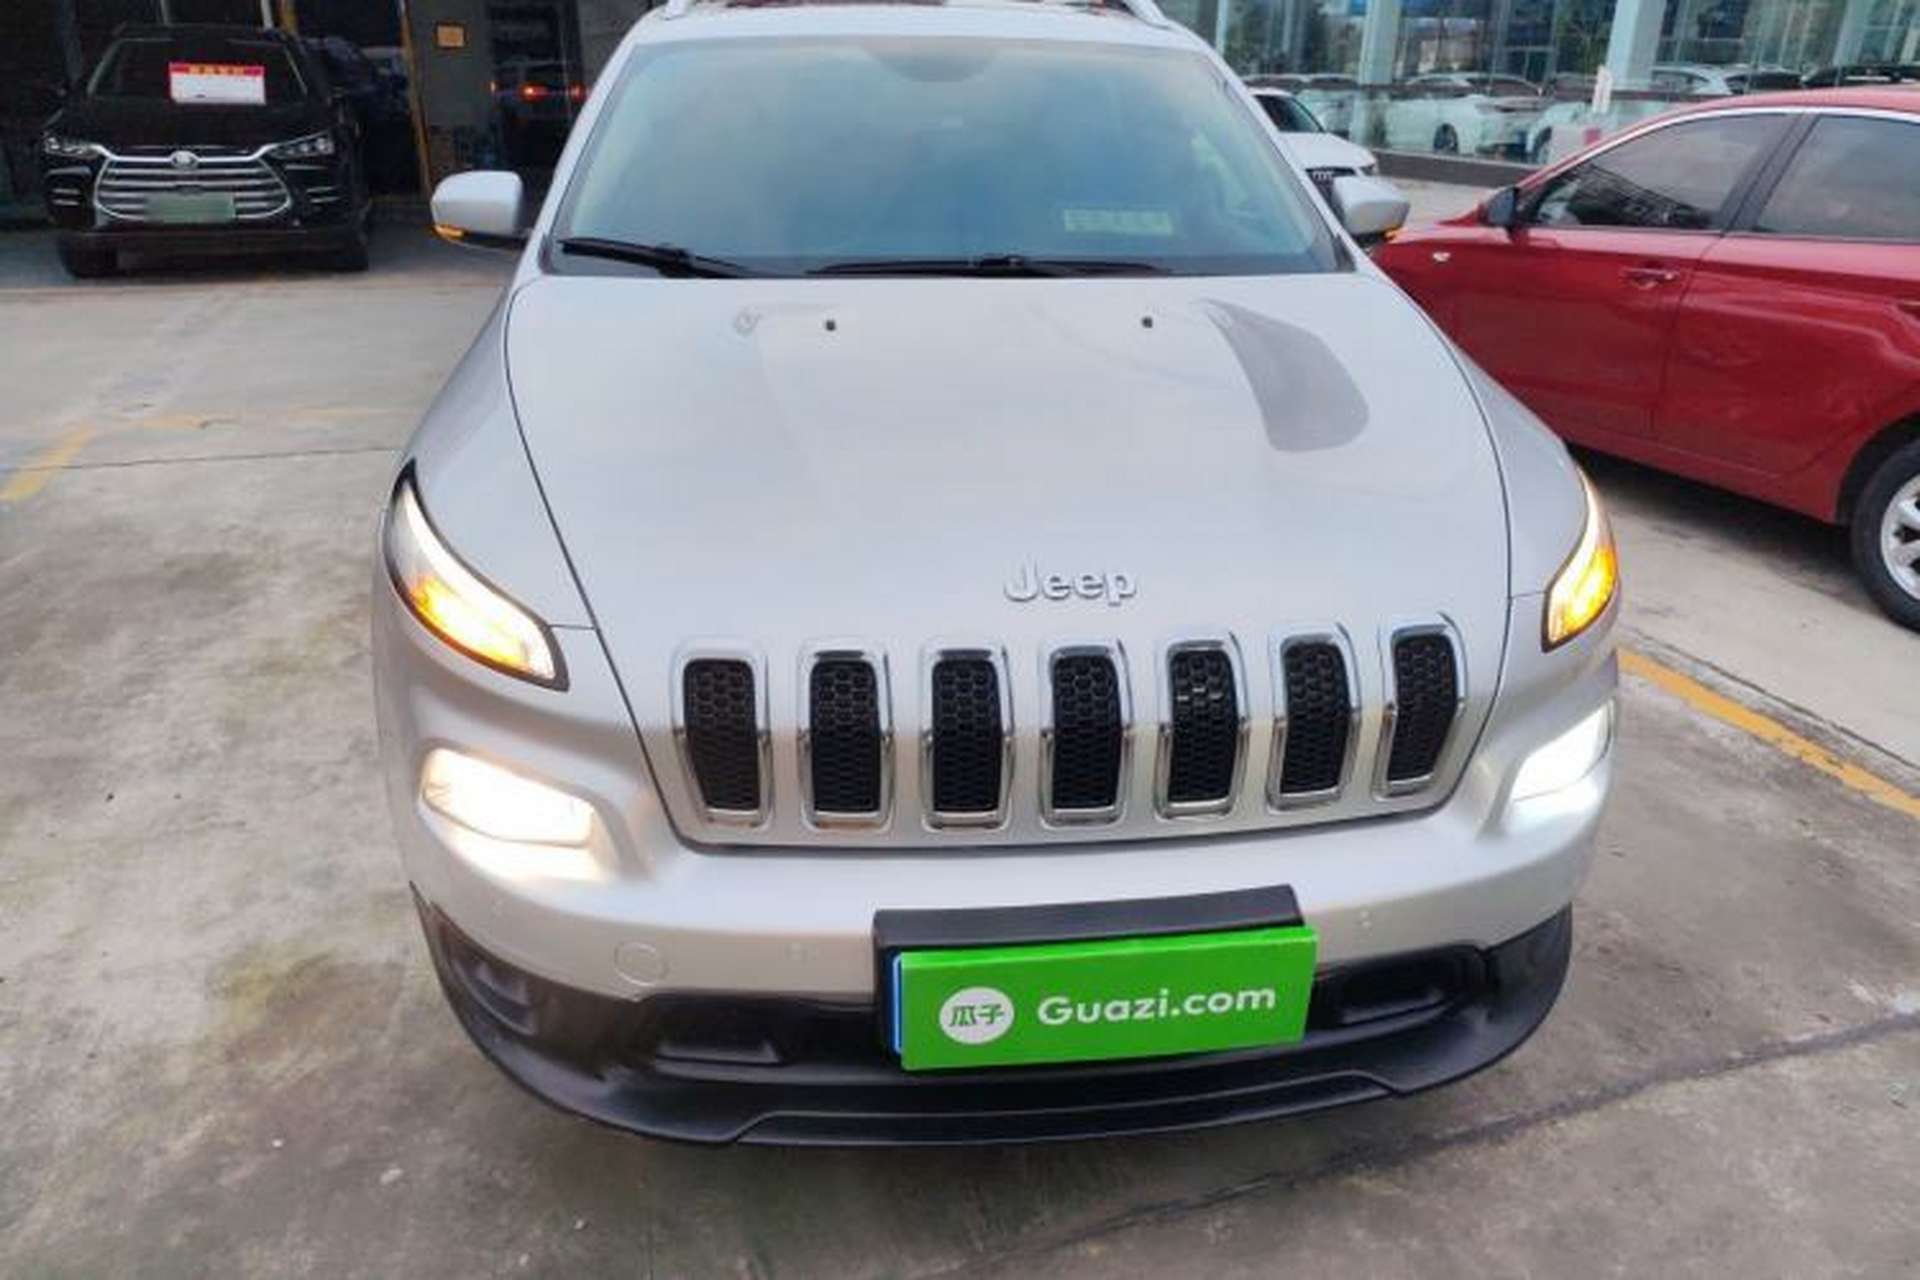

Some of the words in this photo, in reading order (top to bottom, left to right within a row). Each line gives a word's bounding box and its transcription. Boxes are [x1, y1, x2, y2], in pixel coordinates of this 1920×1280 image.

[1003, 556, 1138, 606] Jeep
[948, 1003, 1006, 1028] 瓜子
[1037, 986, 1276, 1026] Guazi.com
